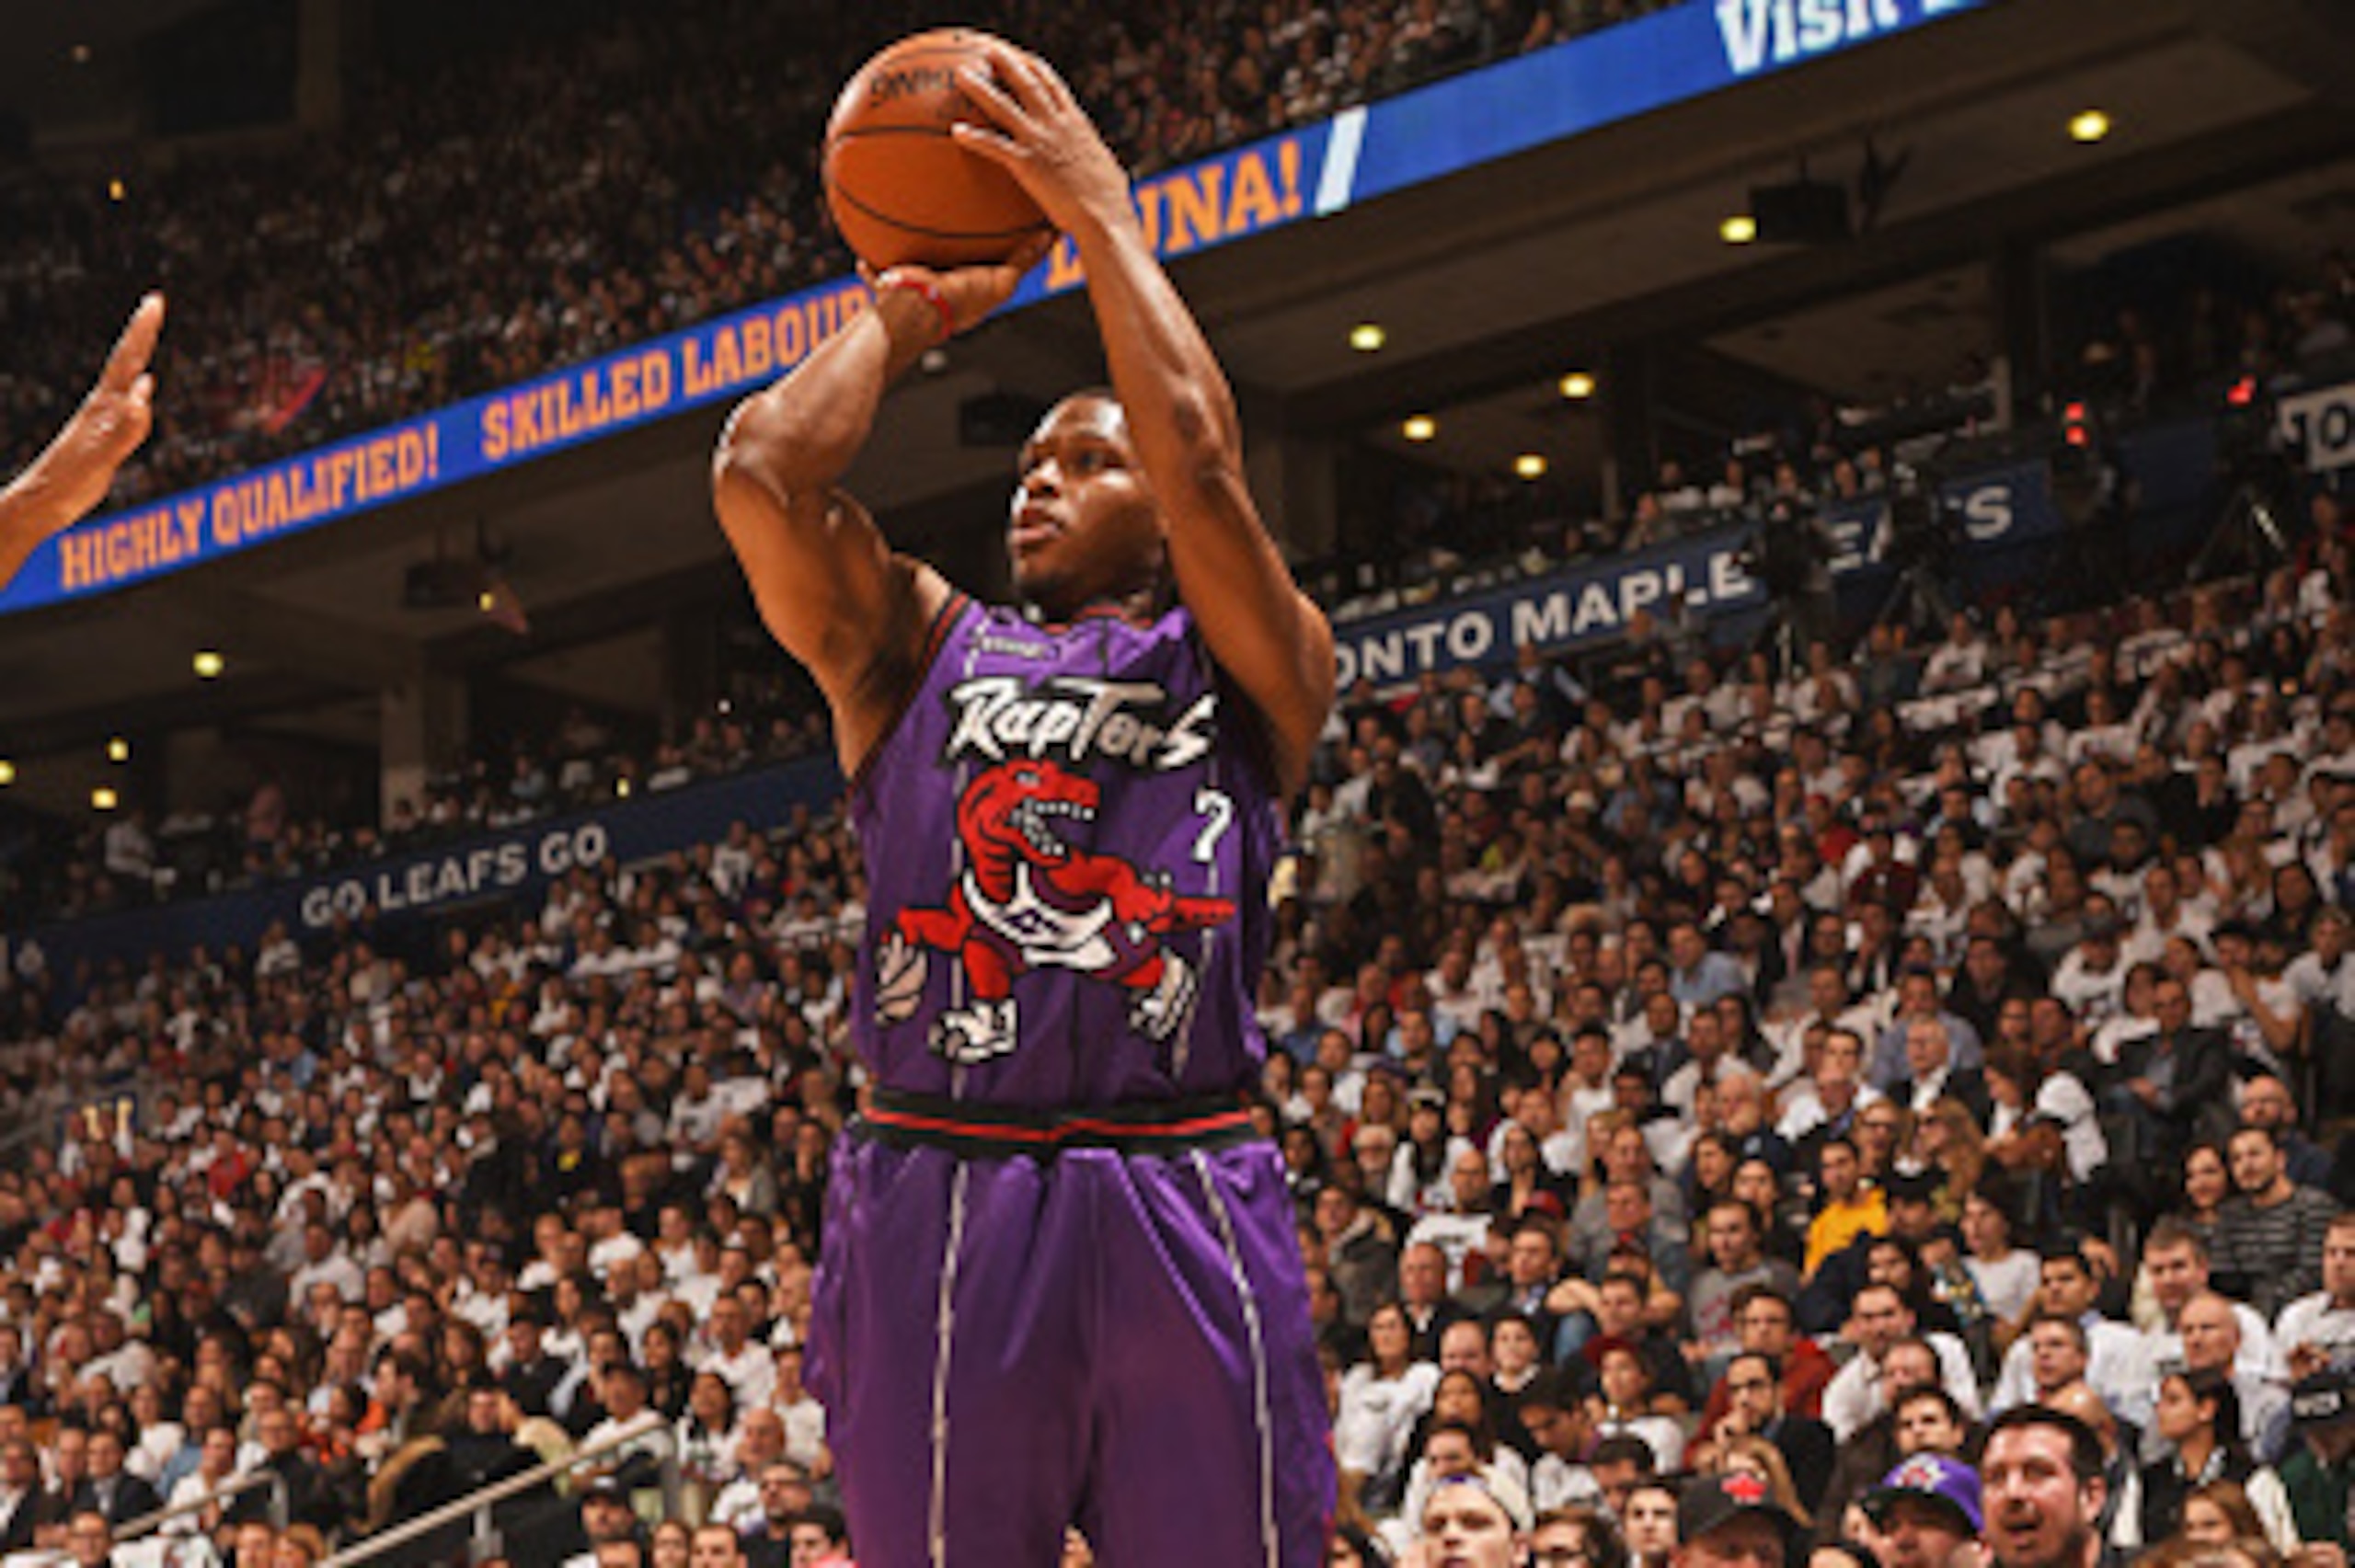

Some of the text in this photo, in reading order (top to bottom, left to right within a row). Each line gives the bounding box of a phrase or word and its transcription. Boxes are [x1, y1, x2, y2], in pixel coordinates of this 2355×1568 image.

[60, 498, 205, 590] HIGHLY
[212, 420, 440, 546] QUALIFIED!
[480, 349, 672, 460] SKILLED
[1044, 139, 1303, 292] LNA!
[1510, 551, 1754, 647] MAPLE
[1193, 788, 1235, 863] 7
[300, 824, 607, 928] GO LEAFS GO
